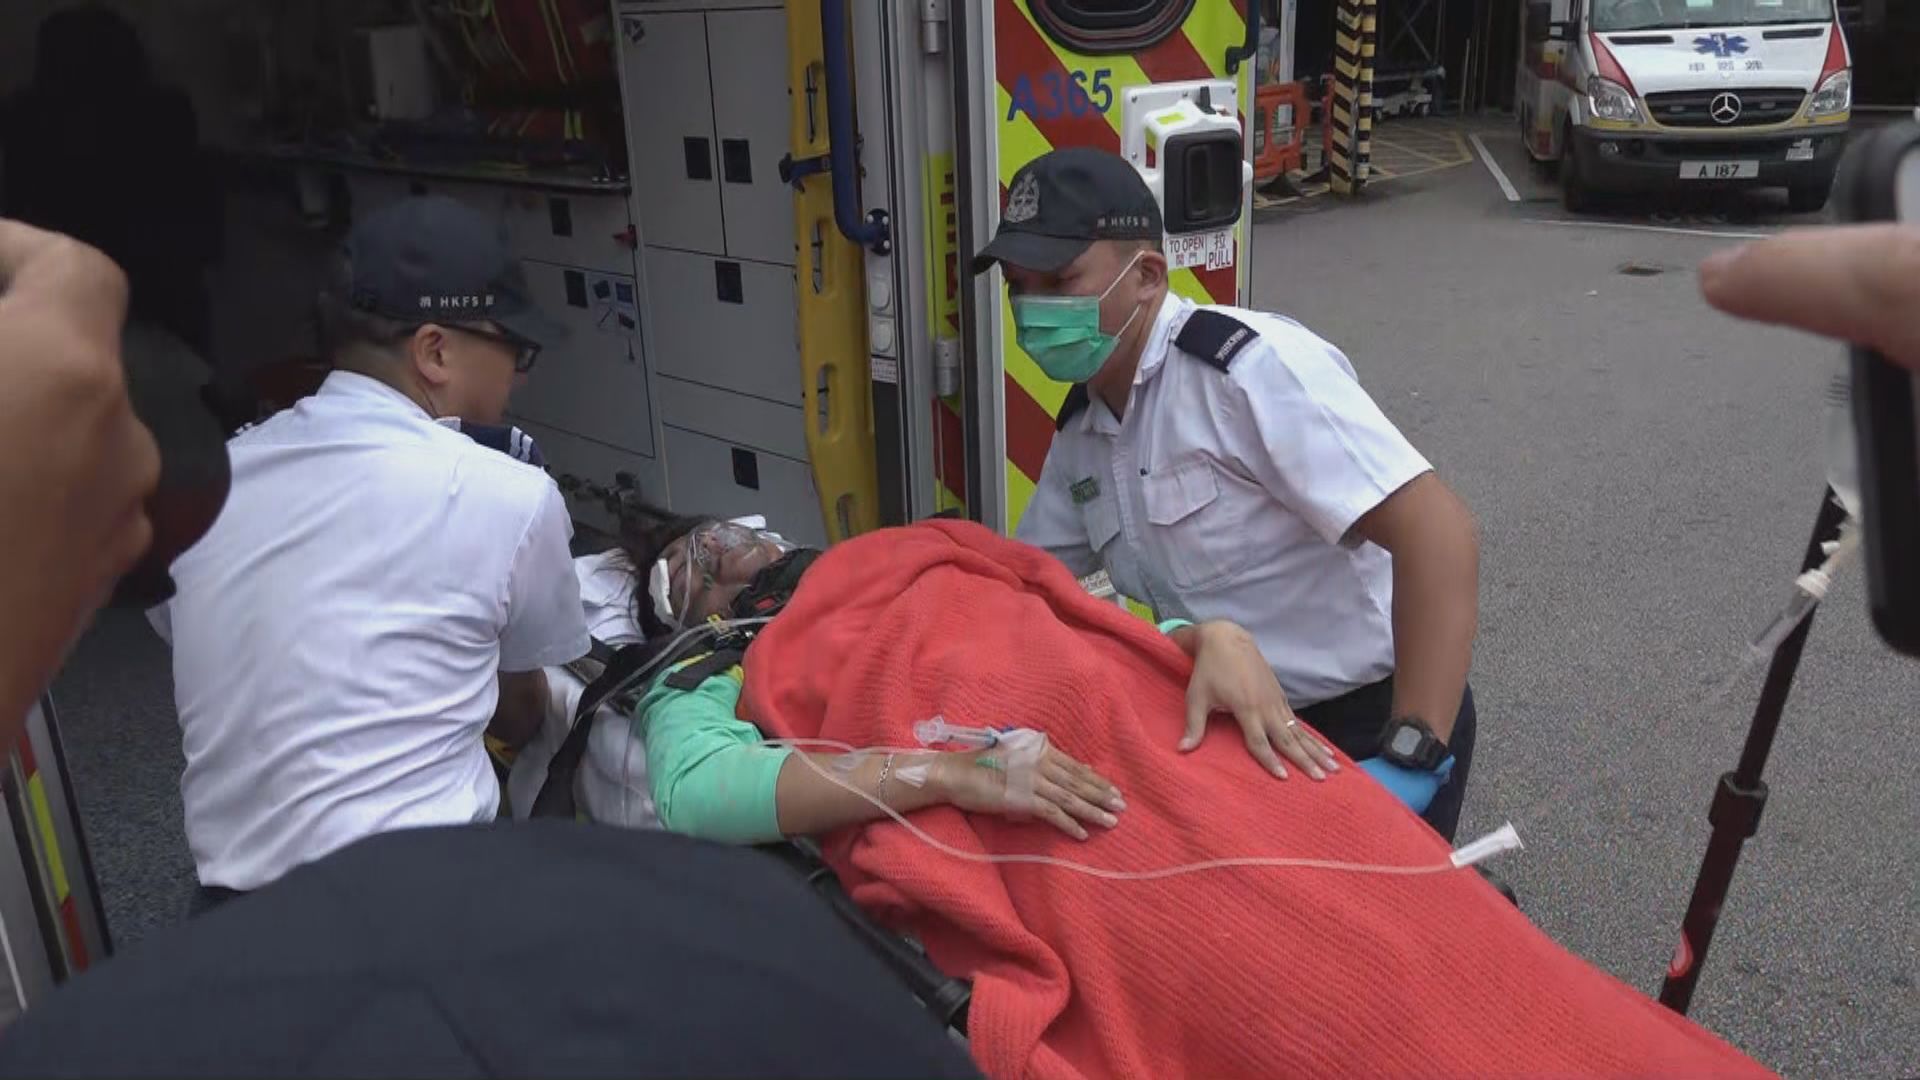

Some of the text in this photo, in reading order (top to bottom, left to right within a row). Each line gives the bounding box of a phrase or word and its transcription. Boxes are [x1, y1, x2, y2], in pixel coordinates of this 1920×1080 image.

[1007, 69, 1113, 121] A365
[1699, 164, 1740, 177] A 187
[1111, 216, 1139, 227] HKFS
[1169, 235, 1205, 253] TO OPEN
[1208, 249, 1231, 269] PULL
[440, 295, 479, 308] HKFS
